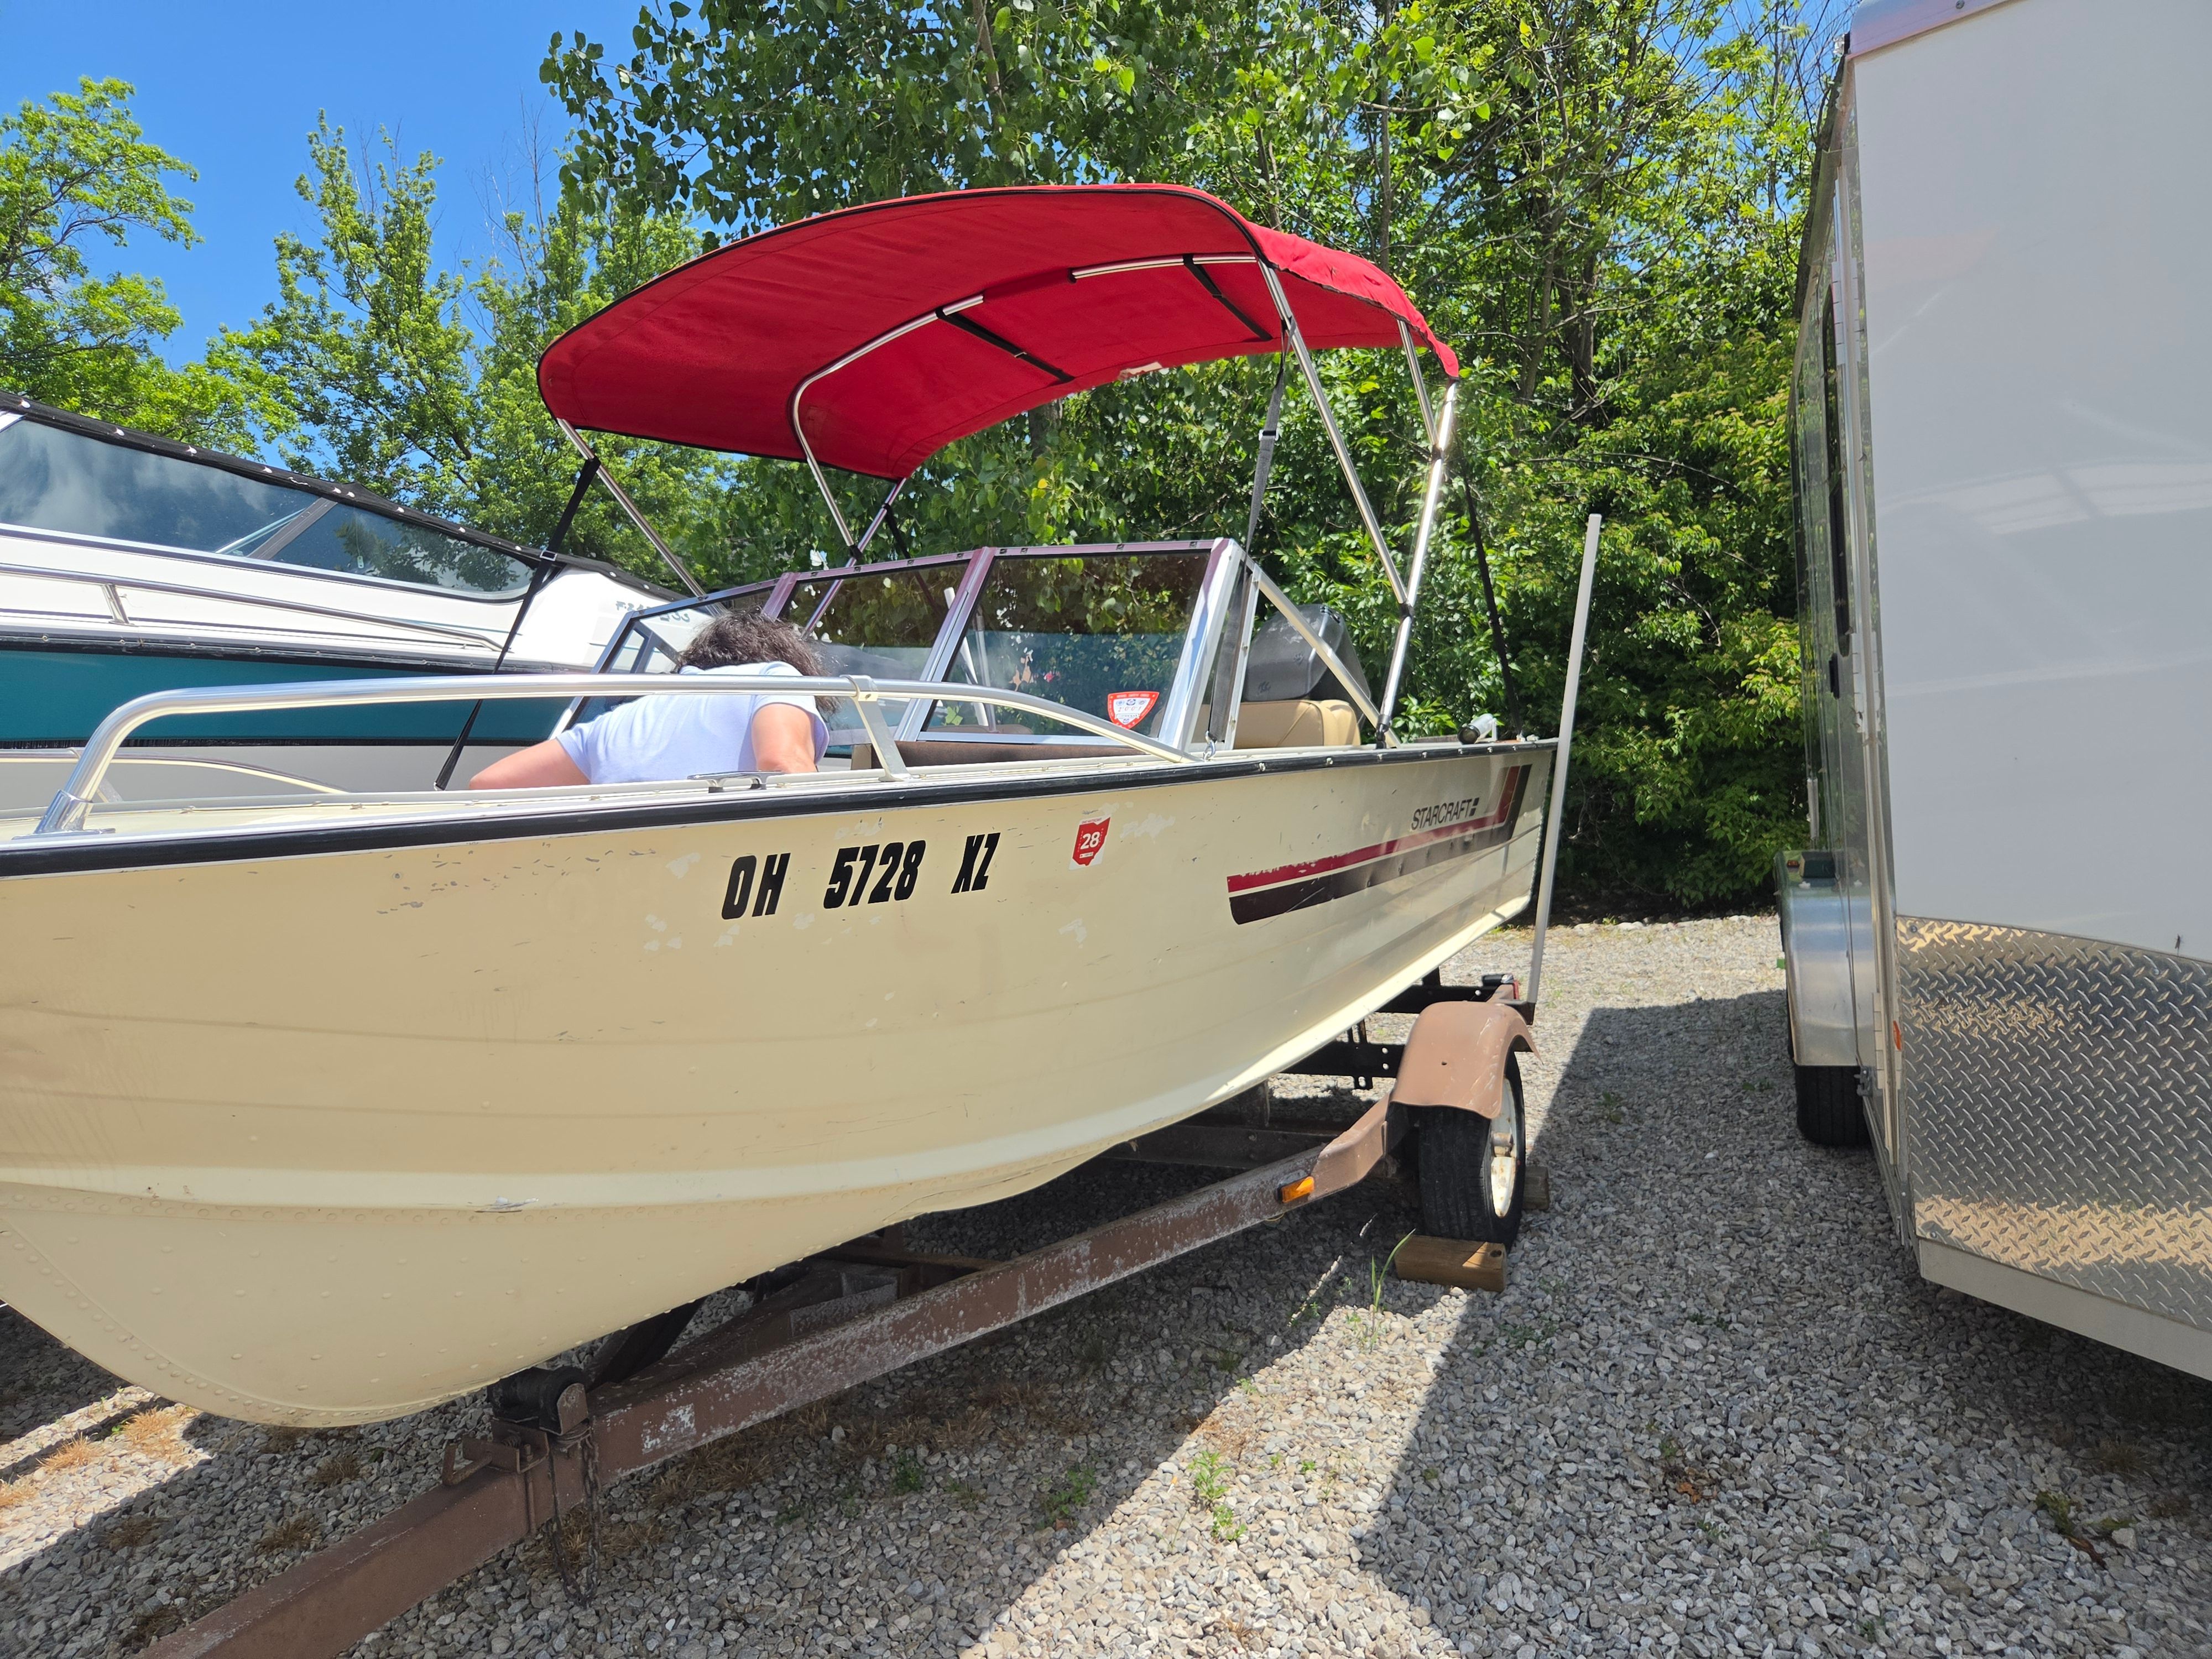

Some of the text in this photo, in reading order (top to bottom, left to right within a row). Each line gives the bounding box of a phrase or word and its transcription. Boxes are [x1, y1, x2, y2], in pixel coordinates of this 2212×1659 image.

[1411, 798, 1473, 831] STARCRAFT
[1080, 831, 1100, 850] 28
[721, 832, 1001, 920] OH 5728 XZ
